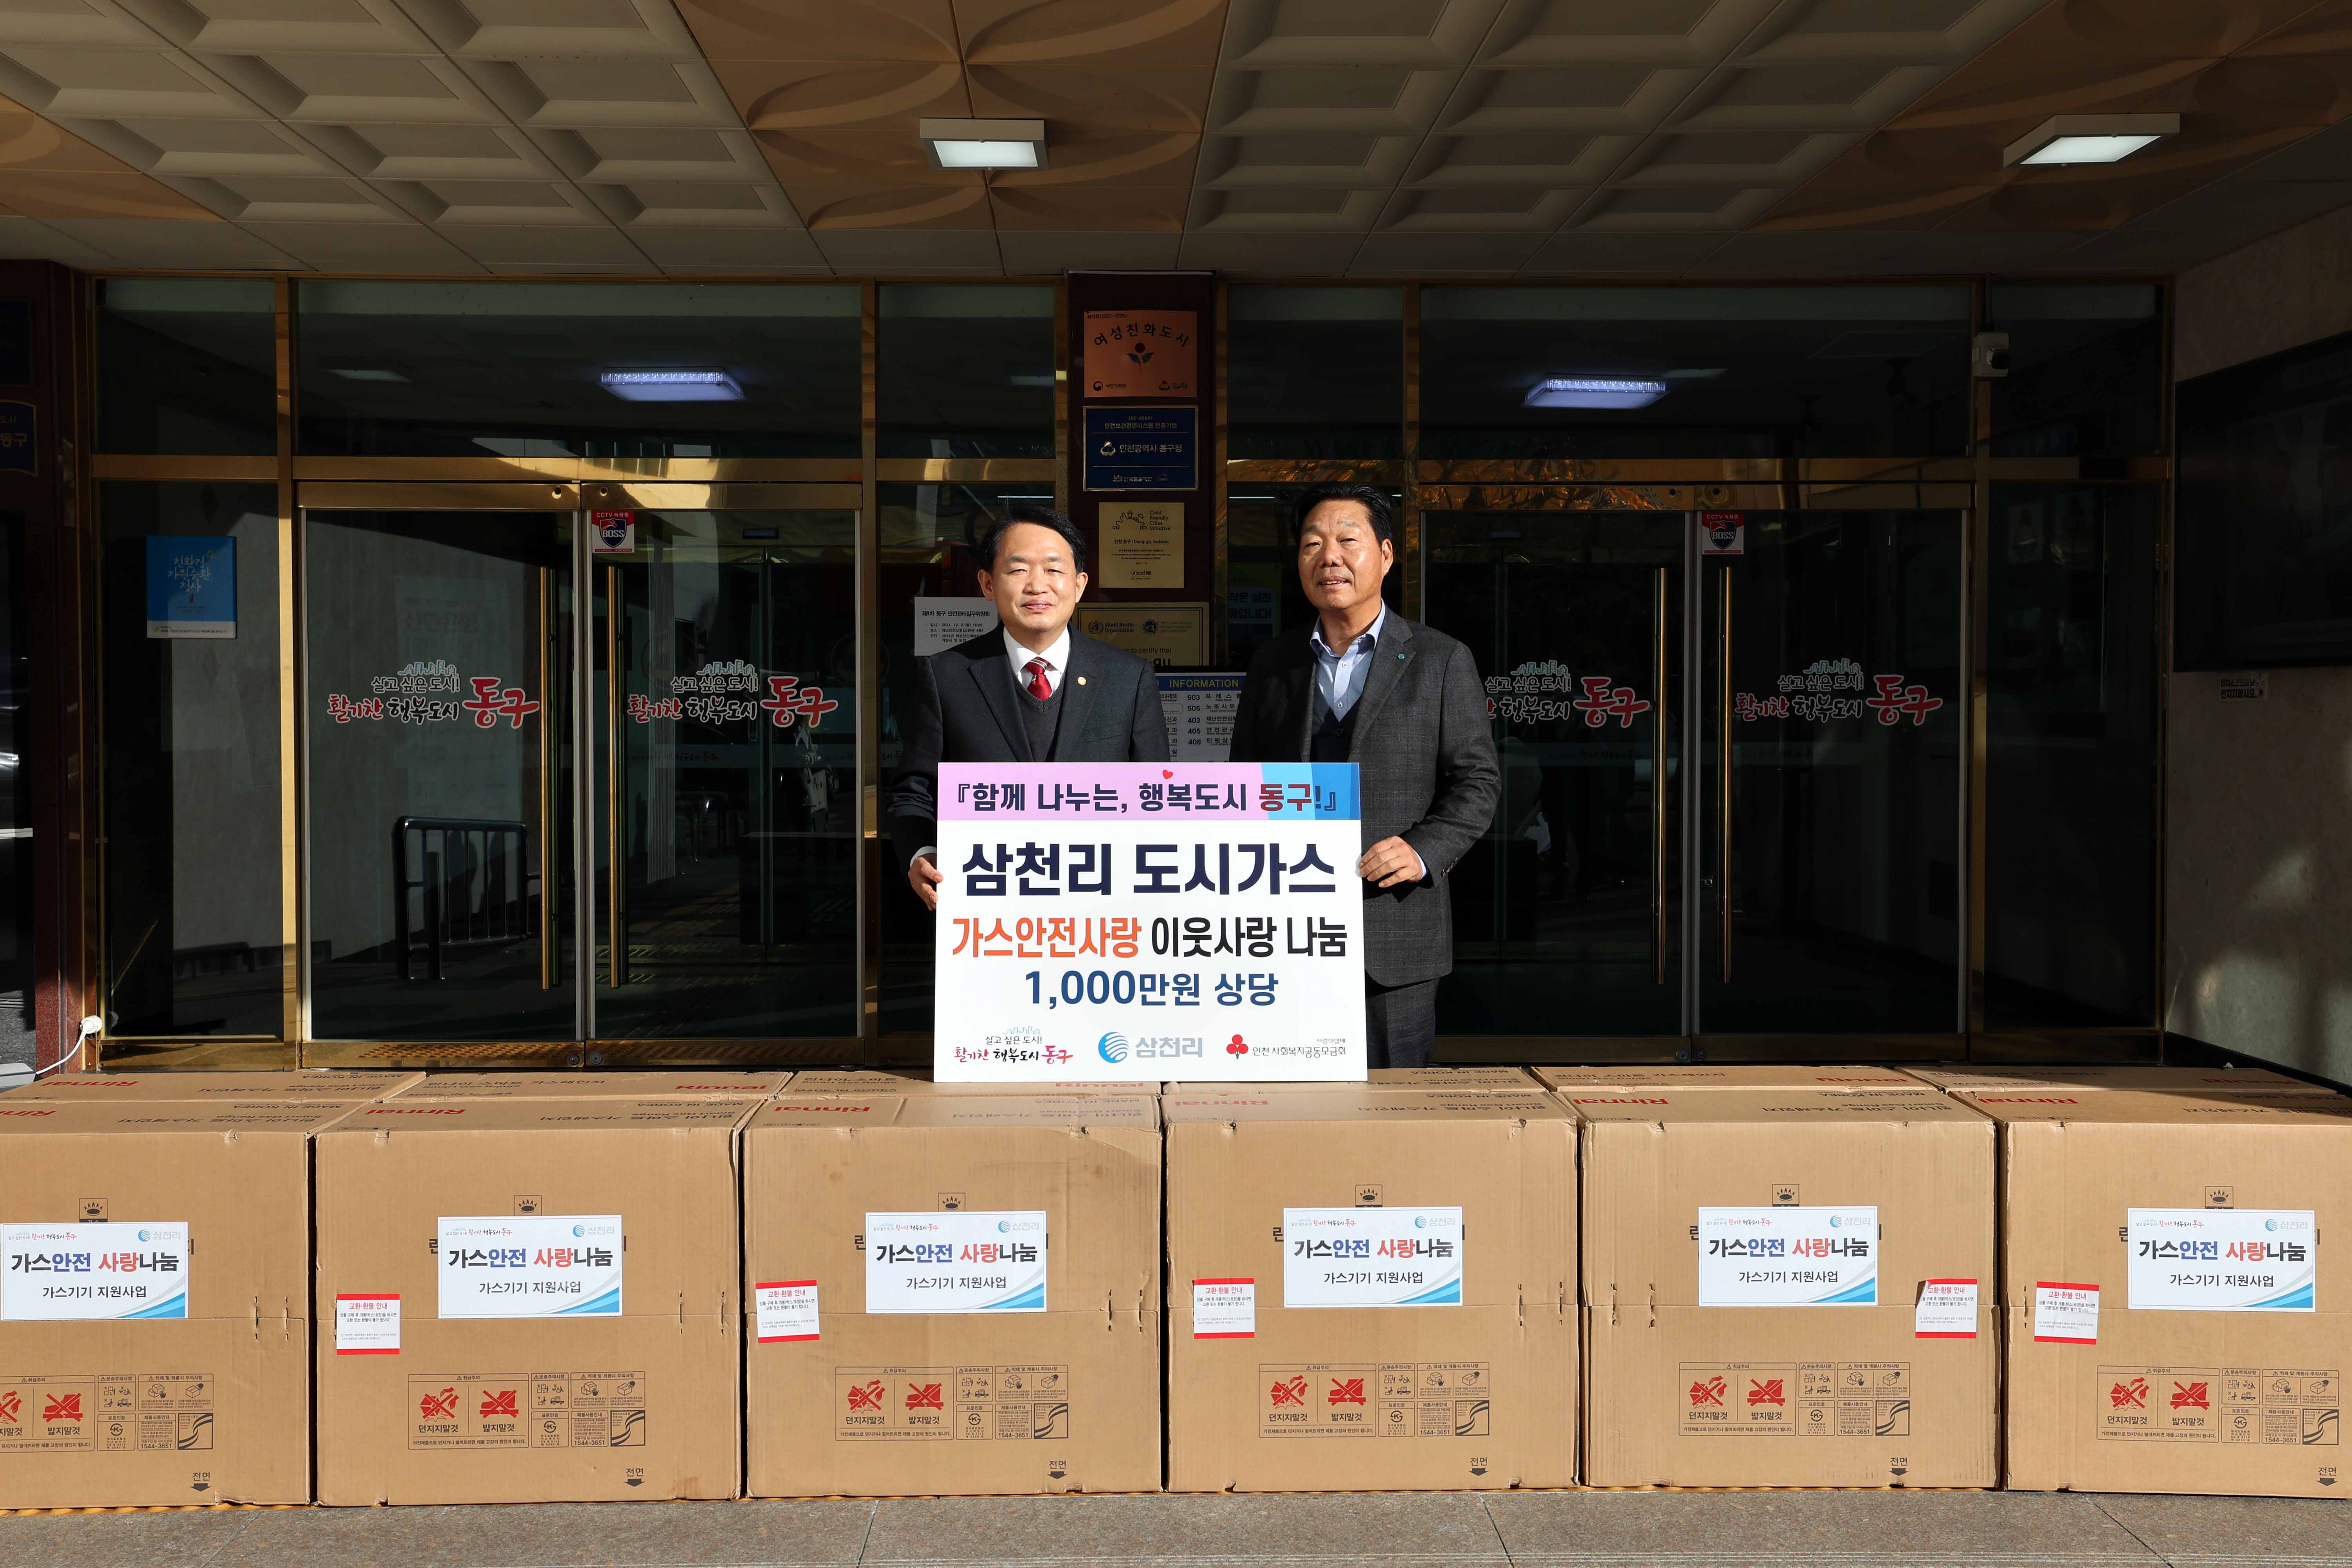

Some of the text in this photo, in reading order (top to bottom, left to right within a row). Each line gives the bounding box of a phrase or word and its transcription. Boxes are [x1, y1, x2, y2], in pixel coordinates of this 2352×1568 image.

[1094, 323, 1189, 347] 여성친화도시
[1120, 444, 1182, 453] 인천광역시 동구청
[1713, 531, 1734, 539] BOSS
[372, 676, 460, 693] 살고 싶은 도시!
[671, 676, 759, 693] 살고 싶은 도시!
[1170, 679, 1239, 687] INFORMATION
[1485, 676, 1571, 693] 살고 싶은 도시!
[1778, 675, 1864, 691] 살고 싶은 도시!
[328, 677, 539, 728] 활기찬 행복도시 동구
[628, 677, 838, 728] 활기찬 행복도시 동구
[1499, 696, 1570, 724] 행복도시
[1573, 677, 1650, 728] 동구
[1735, 674, 1943, 726] 활기찬 행복도시 동구
[1038, 784, 1127, 813] 나누는,
[1139, 782, 1246, 811] 행복도시
[963, 842, 1336, 896] 삼천리 도시가스
[953, 917, 1347, 958] 가스안전사랑 이웃사랑 나눔
[1026, 971, 1278, 1009] 1,000만원 상당
[985, 1036, 1001, 1045] 살고
[1005, 1036, 1020, 1044] 싶은
[1136, 1037, 1202, 1058] 삼천리
[1253, 1047, 1345, 1058] 인천 사회복지공동모금회
[954, 1045, 1073, 1064] 활기찬 행복도시 동구
[1013, 1223, 1039, 1231] 삼천리
[1429, 1218, 1455, 1227] 삼천리
[1845, 1217, 1870, 1226] 삼천리
[2280, 1221, 2308, 1230] 삼천리
[588, 1227, 614, 1235] 삼천리
[876, 1243, 1038, 1264] 가스안전 사랑나눔
[1294, 1238, 1454, 1259] 가스안전 사랑나눔
[1709, 1238, 1869, 1258] 가스안전 사랑나눔
[2139, 1240, 2306, 1262] 가스안전 사랑나눔
[11, 1252, 179, 1273] 가스안전 사랑나눔
[448, 1247, 613, 1269] 가스안전 사랑나눔
[906, 1276, 1006, 1289] 가스기기 지원사업
[1324, 1272, 1423, 1284] 가스기기 지원사업
[1739, 1271, 1838, 1283] 가스기기 지원사업
[2170, 1274, 2274, 1287] 가스기기 지원사업
[43, 1285, 146, 1299] 가스기기 지원사업
[479, 1281, 581, 1294] 가스기기 지원사업
[846, 1416, 885, 1425] 던지지말것
[908, 1416, 939, 1425] 밟지말것
[1269, 1413, 1307, 1422] 던지지말것
[1331, 1413, 1362, 1421] 밟지말것
[1689, 1411, 1728, 1420] 던지지말것
[1751, 1412, 1782, 1420] 밟지말것
[2107, 1416, 2147, 1425] 던지지말것
[2172, 1417, 2204, 1426] 밟지말것
[47, 1426, 80, 1436] 밟지말것
[419, 1424, 458, 1433] 던지지말것
[483, 1423, 514, 1432] 밟지말것
[1049, 1460, 1066, 1469] 전면
[1470, 1457, 1488, 1466] 전면
[1890, 1457, 1907, 1466] 전면
[192, 1472, 211, 1481] 전면
[626, 1468, 643, 1477] 전면
[2318, 1466, 2337, 1476] 전면
